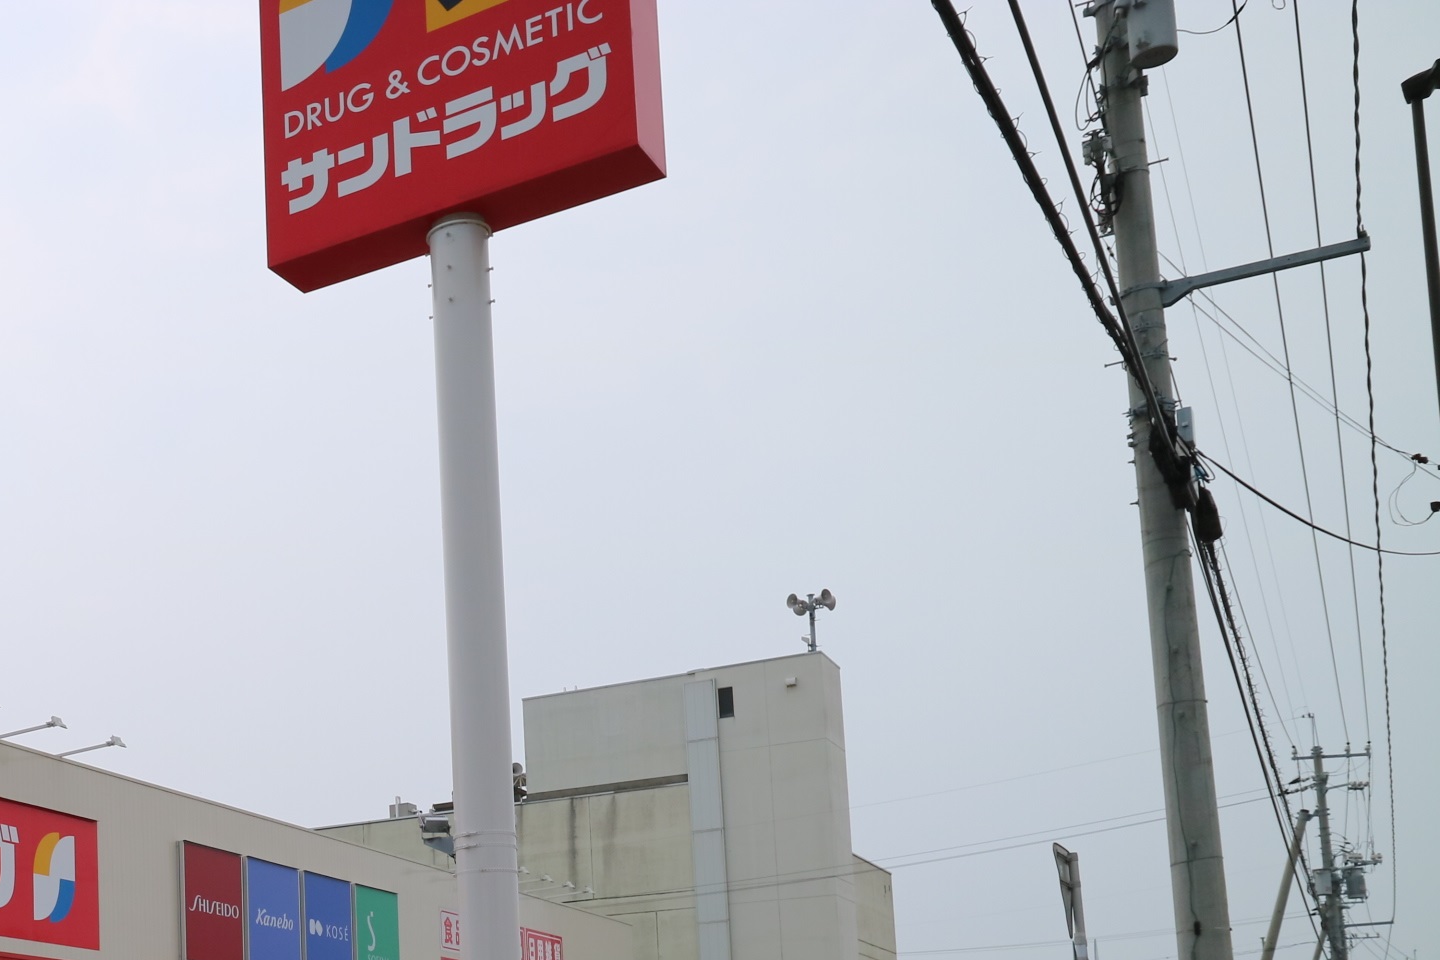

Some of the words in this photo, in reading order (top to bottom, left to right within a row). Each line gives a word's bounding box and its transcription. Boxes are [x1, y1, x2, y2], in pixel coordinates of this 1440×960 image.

[284, 83, 374, 139] DRUG
[385, 70, 410, 100] &
[417, 0, 603, 85] COSMETIC
[281, 42, 612, 215] サンドラッグ
[188, 894, 240, 919] SHISEIDO
[255, 908, 294, 931] Kanebo
